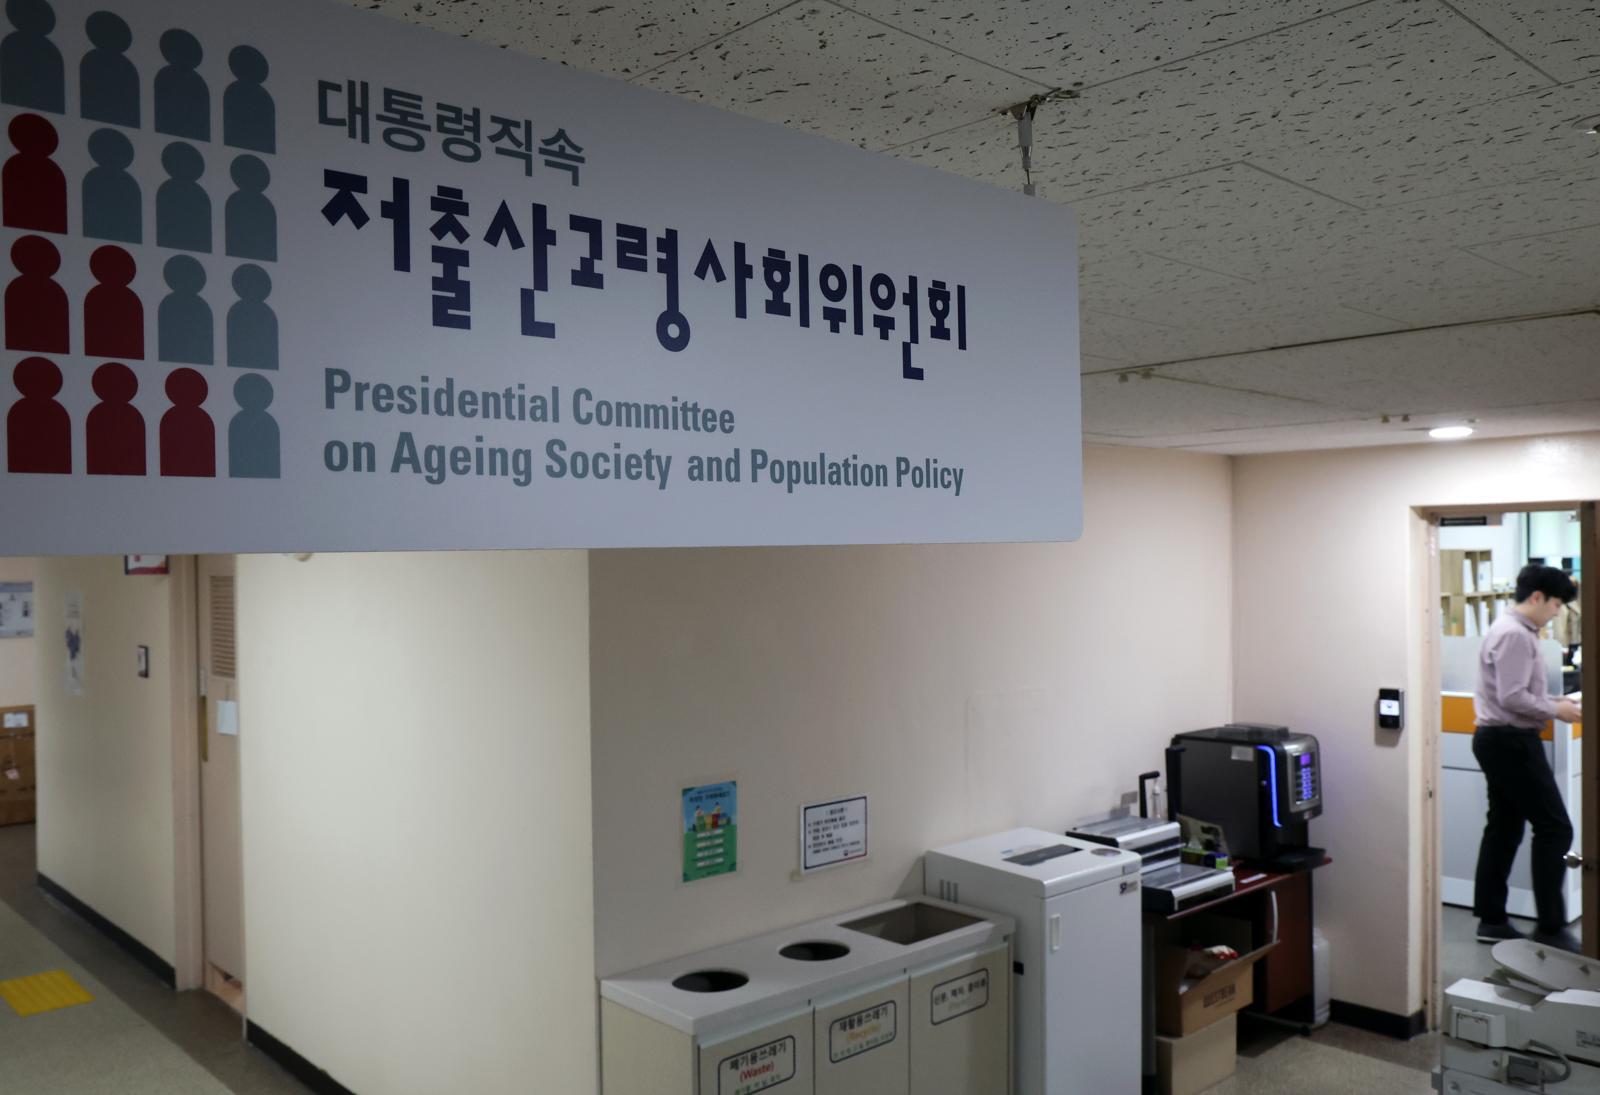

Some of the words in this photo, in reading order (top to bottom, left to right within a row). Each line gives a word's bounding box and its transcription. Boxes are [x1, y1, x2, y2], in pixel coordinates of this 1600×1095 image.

[317, 79, 586, 187] 대통령직속
[320, 168, 967, 381] 저출산고령사회위원회
[325, 368, 560, 424] Presidential
[573, 388, 735, 435] Committee
[324, 440, 377, 473] on
[391, 432, 533, 487] Ageing
[546, 439, 673, 490] Society
[688, 449, 741, 484] and
[751, 449, 889, 493] Population
[896, 456, 964, 497] Policy
[739, 1060, 775, 1083] (Waste)
